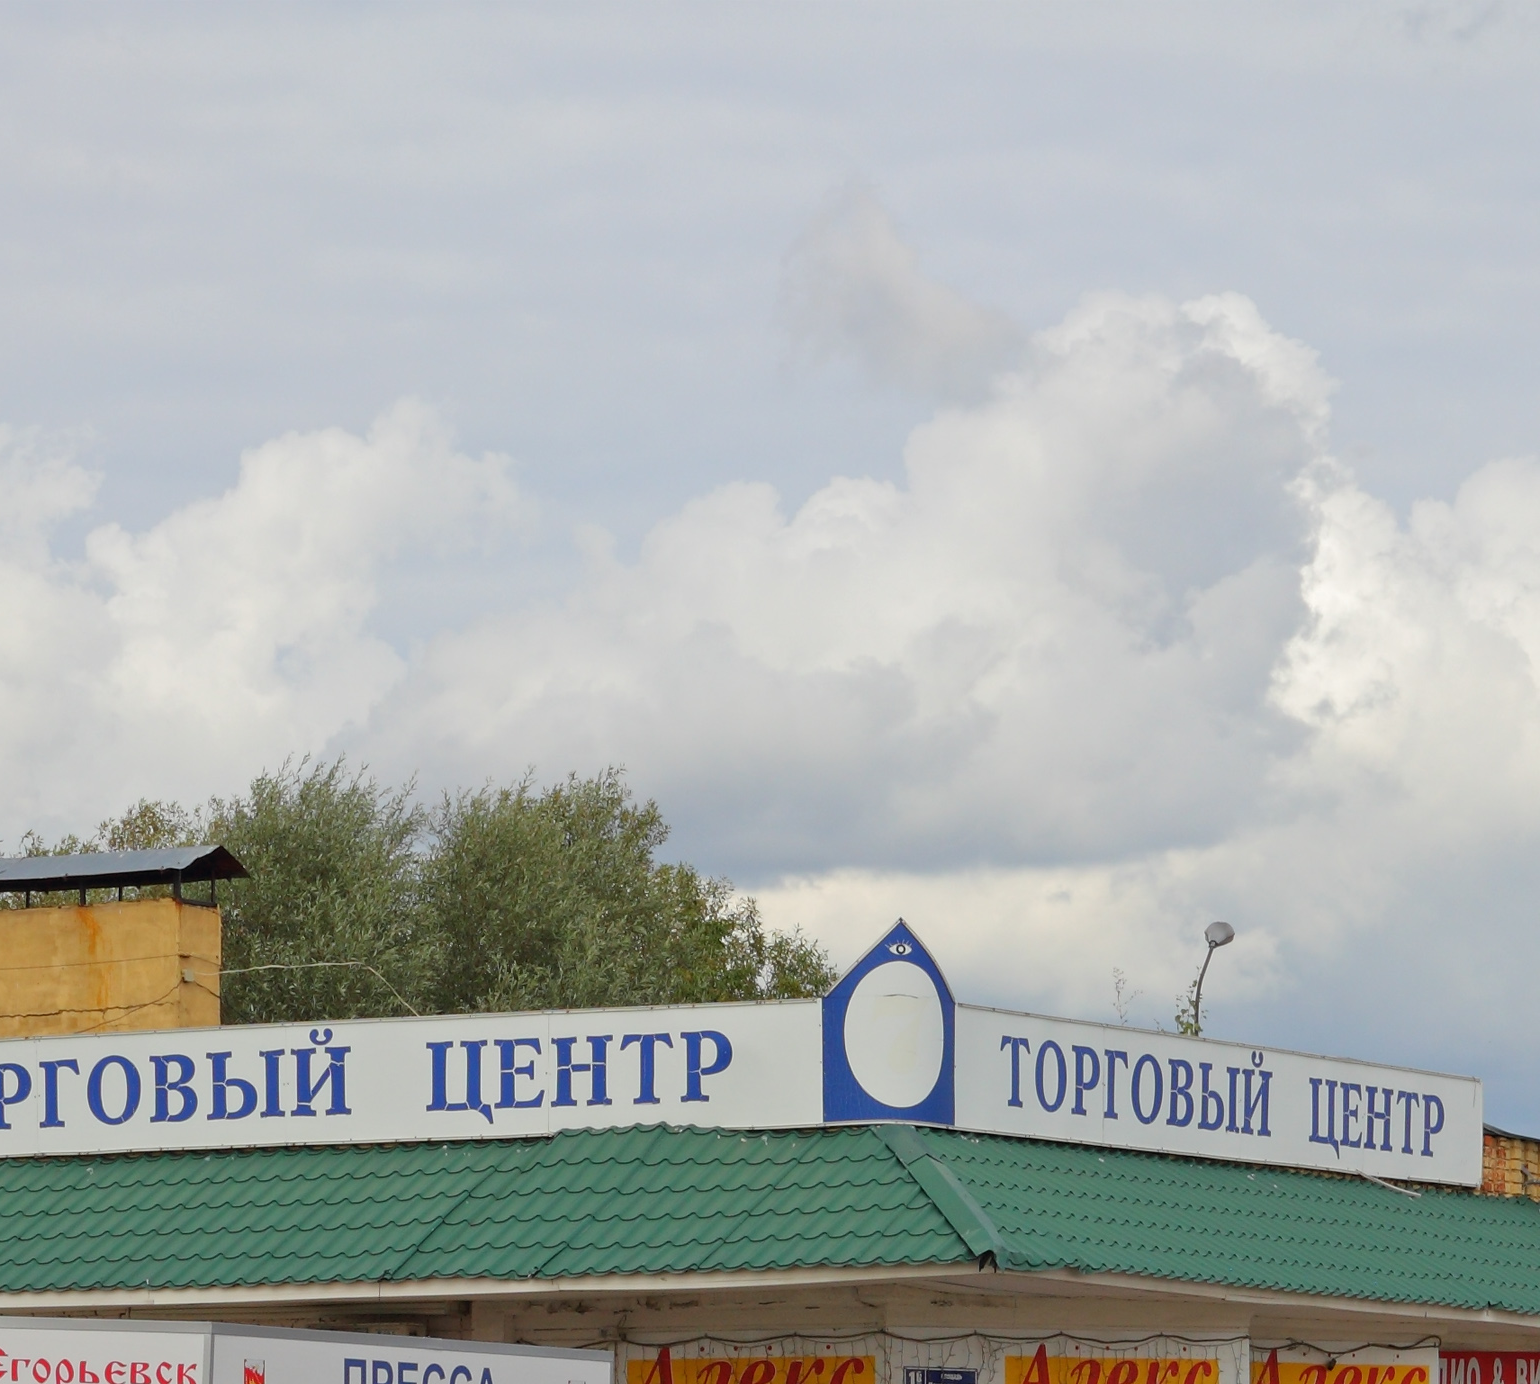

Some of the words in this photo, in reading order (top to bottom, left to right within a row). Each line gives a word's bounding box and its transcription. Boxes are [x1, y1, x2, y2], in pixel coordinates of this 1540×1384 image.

[426, 1030, 733, 1124] ЦЕНТР
[1000, 1035, 1273, 1137] ТОРГОВЫЙ
[1308, 1076, 1445, 1159] ЦЕНТР
